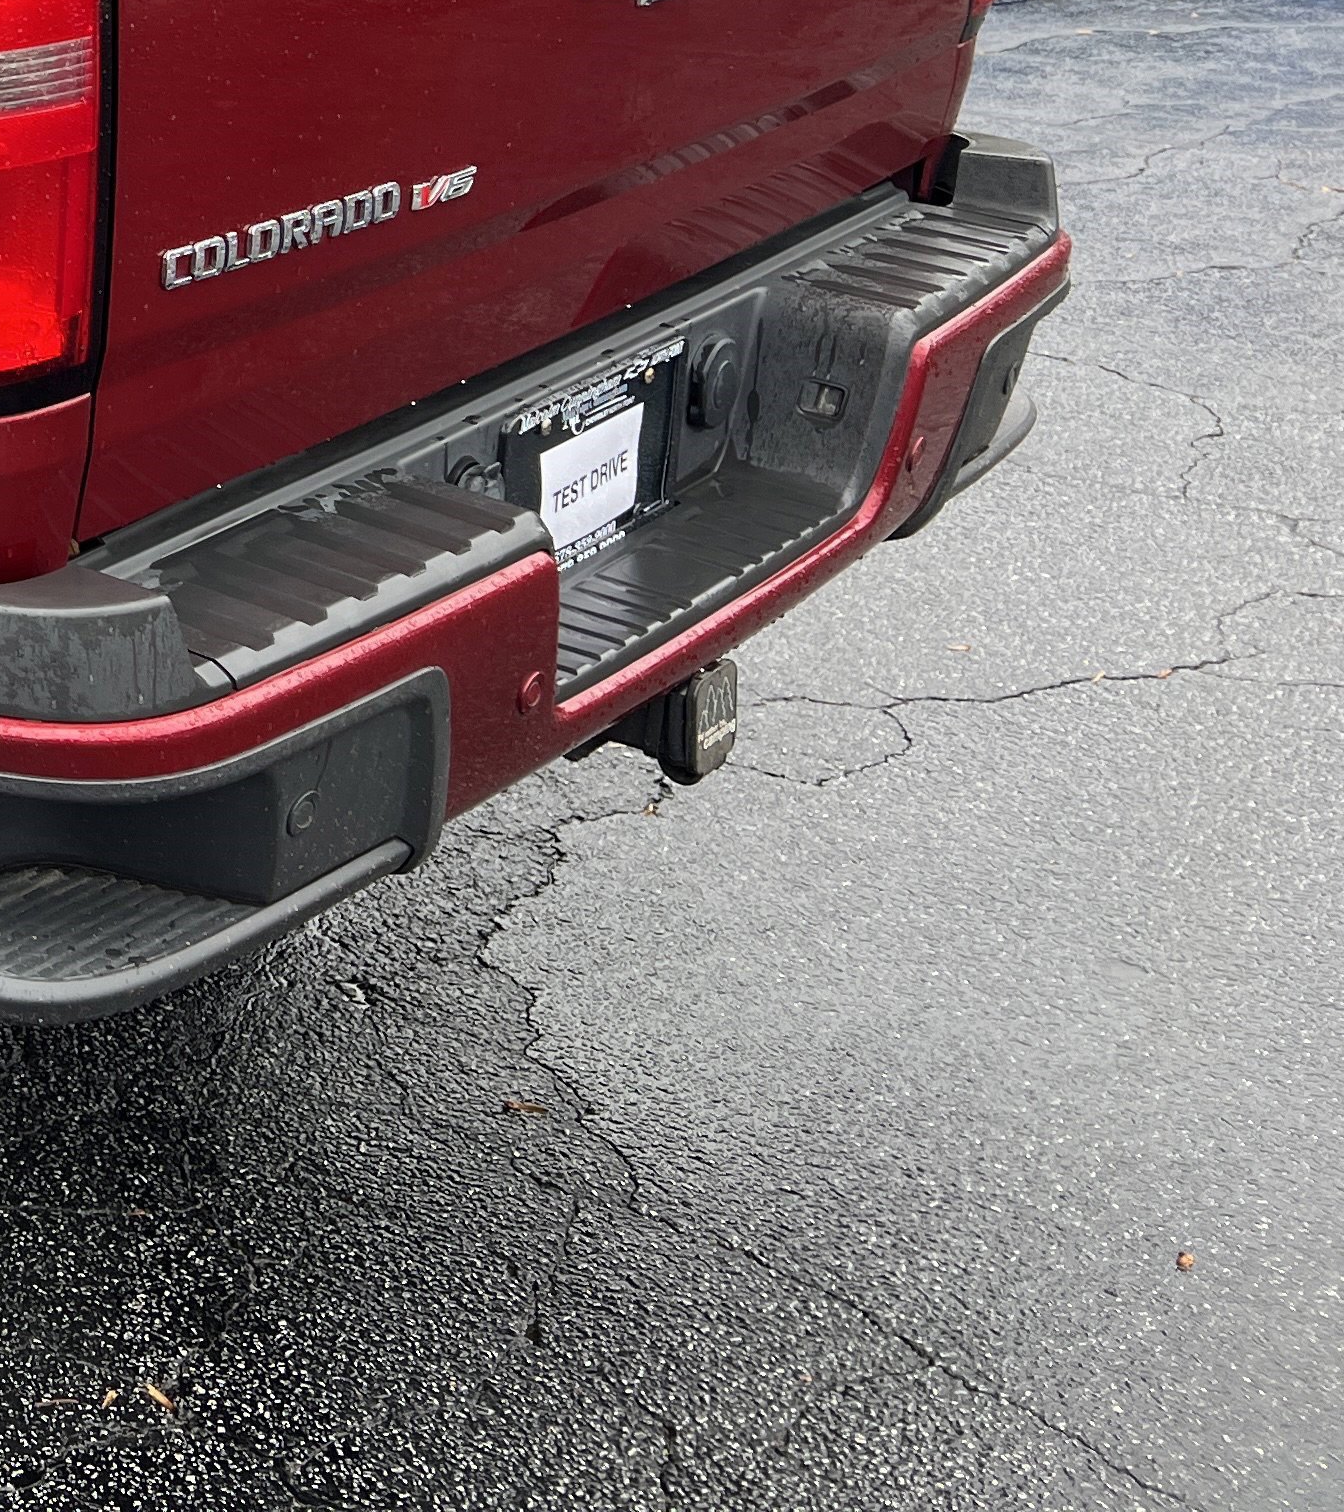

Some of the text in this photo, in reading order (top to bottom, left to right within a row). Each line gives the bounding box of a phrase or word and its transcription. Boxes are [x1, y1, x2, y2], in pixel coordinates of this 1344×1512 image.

[162, 165, 477, 290] COLORADO V6
[552, 449, 629, 513] TEST DRIVE
